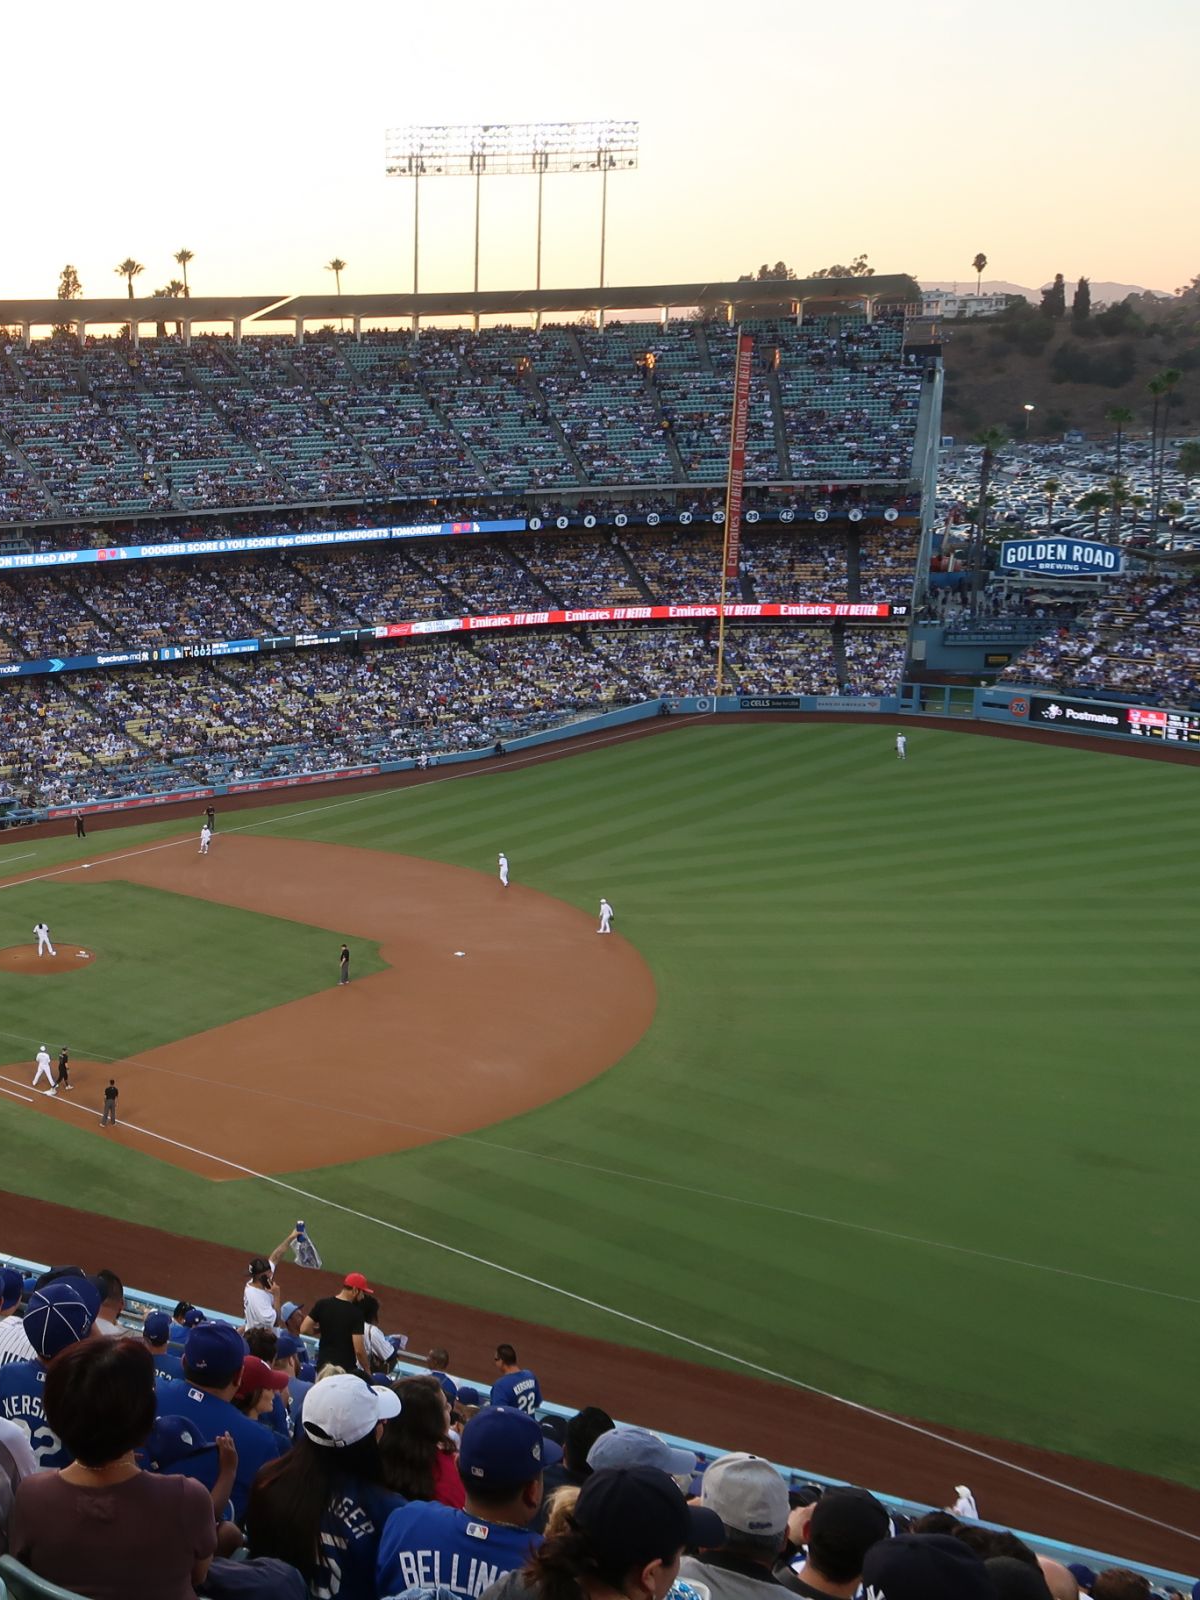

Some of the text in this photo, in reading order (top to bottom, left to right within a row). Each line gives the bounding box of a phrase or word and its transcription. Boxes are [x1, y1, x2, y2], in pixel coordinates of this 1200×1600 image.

[738, 351, 751, 378] BETTER
[734, 399, 748, 451] Emirates
[731, 469, 743, 498] BETTER
[141, 525, 442, 557] DODGERS SCORE 6 YOU SCORE 6pc CHICKEN MCNUGGETS TOMORROW
[727, 515, 740, 566] Emirates
[15, 554, 34, 566] THE
[35, 552, 57, 564] McD
[58, 552, 78, 563] APP
[1006, 543, 1116, 569] GOLDEN ROAD
[1038, 562, 1080, 571] BREWING
[564, 606, 653, 622] Emirates FLY BETTER
[669, 605, 718, 618] Emirates
[735, 604, 763, 616] BETTER
[780, 604, 879, 616] Emirates FLY BETTER
[469, 611, 550, 629] Emirates FLY BETTER
[96, 653, 130, 665] Spectrum
[153, 651, 159, 661] 0
[164, 650, 170, 660] 0
[193, 649, 200, 657] 0
[200, 648, 206, 656] 0
[206, 647, 212, 656] 2
[750, 699, 771, 708] CELLS
[1012, 703, 1024, 713] 76
[1065, 708, 1119, 726] Postmates
[517, 1391, 536, 1415] 22
